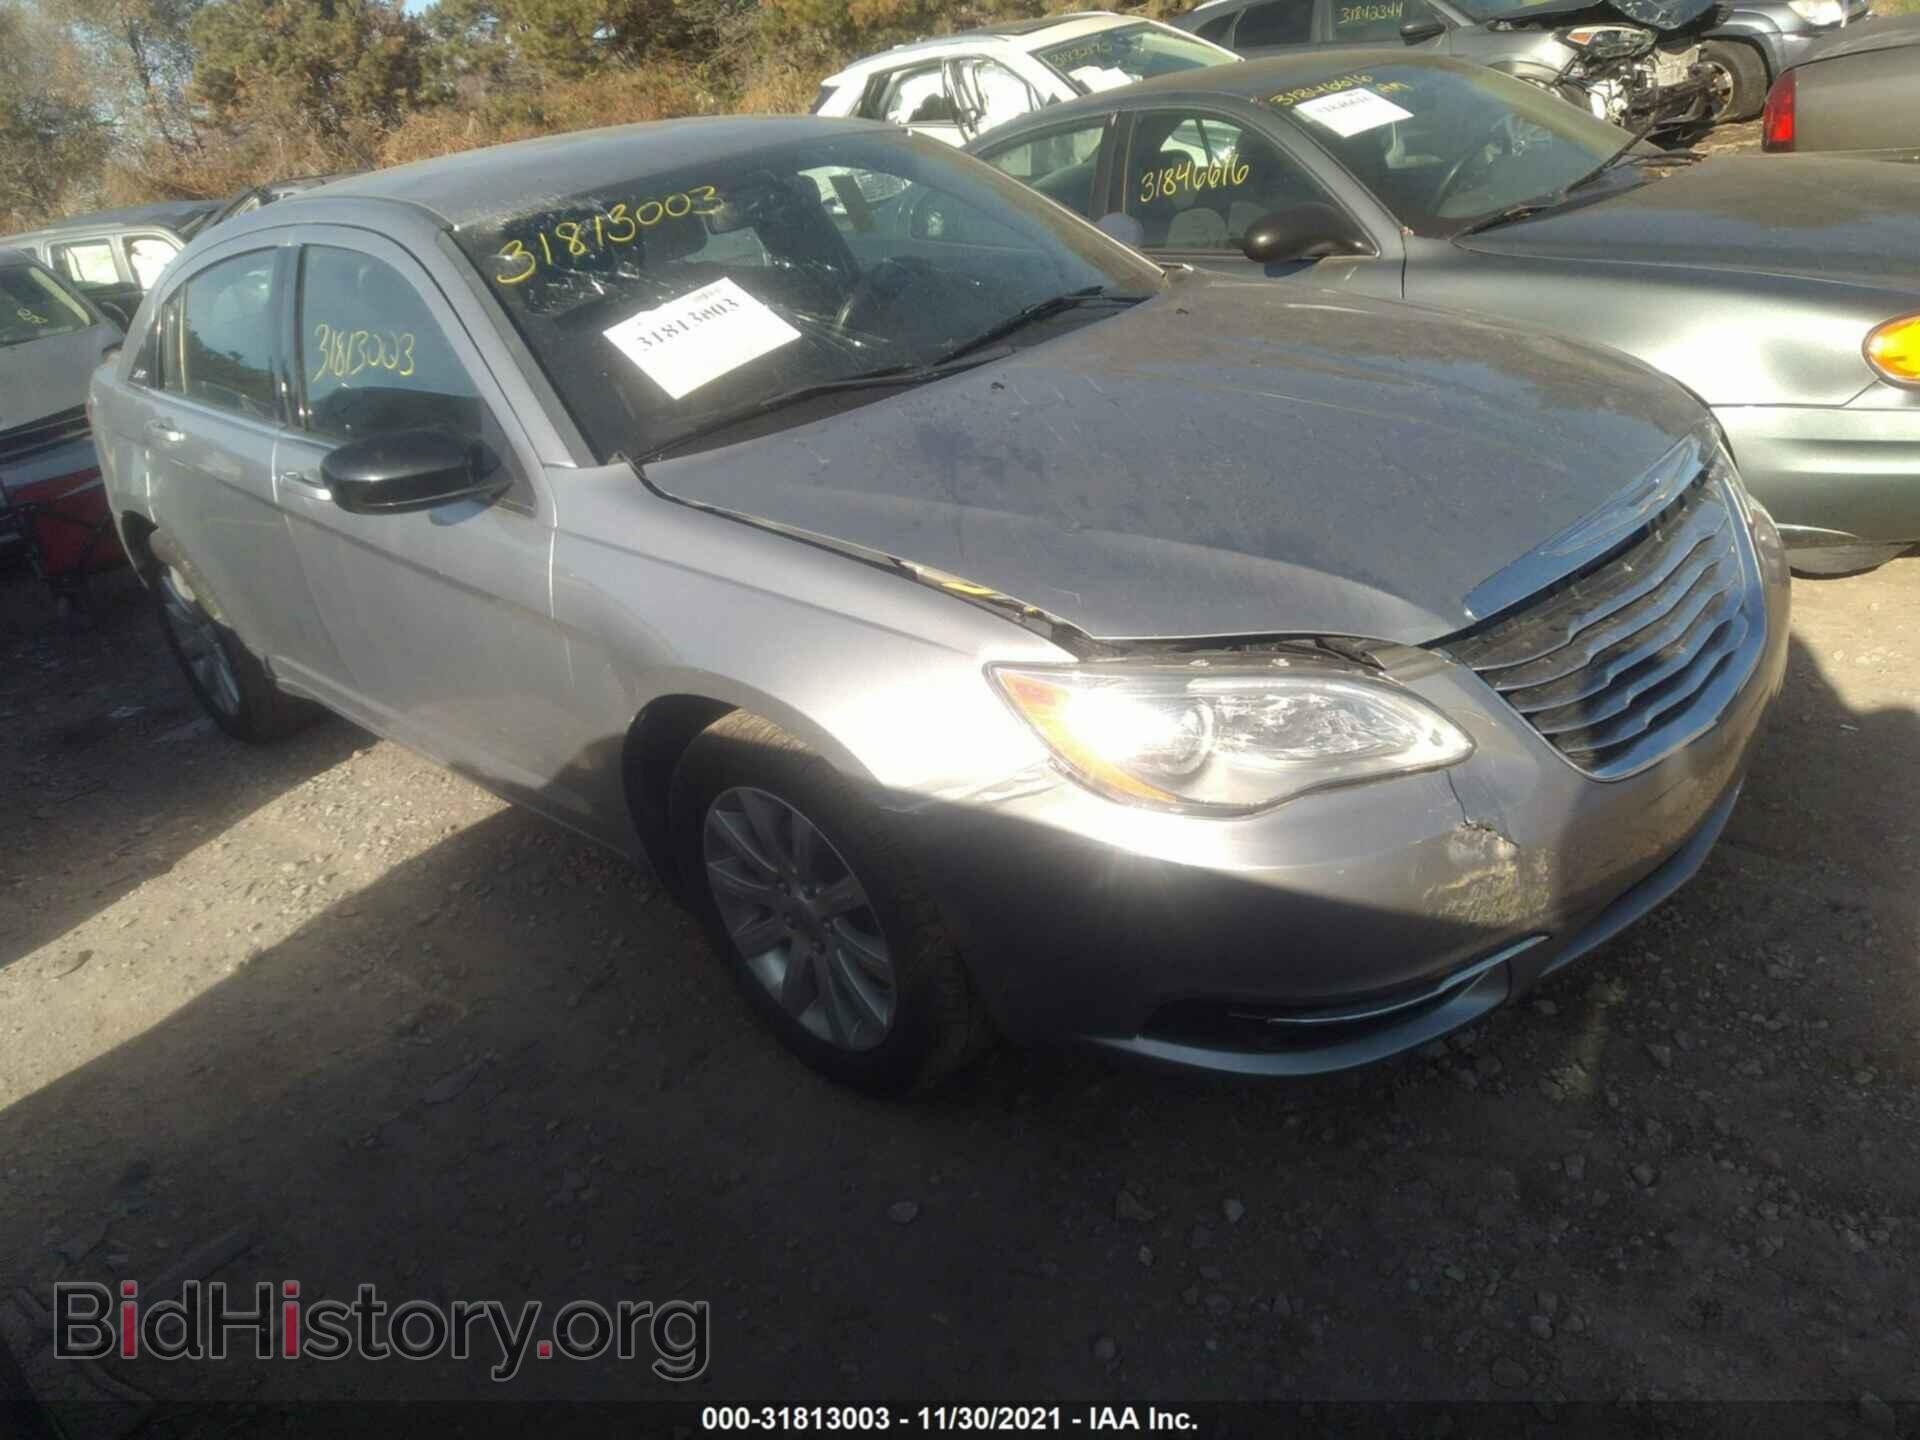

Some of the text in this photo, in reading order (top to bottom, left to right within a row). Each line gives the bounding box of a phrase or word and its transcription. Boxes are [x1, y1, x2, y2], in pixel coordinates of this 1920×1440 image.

[1140, 153, 1250, 203] 31846616
[496, 185, 725, 284] 31813003
[312, 323, 415, 383] 31813003
